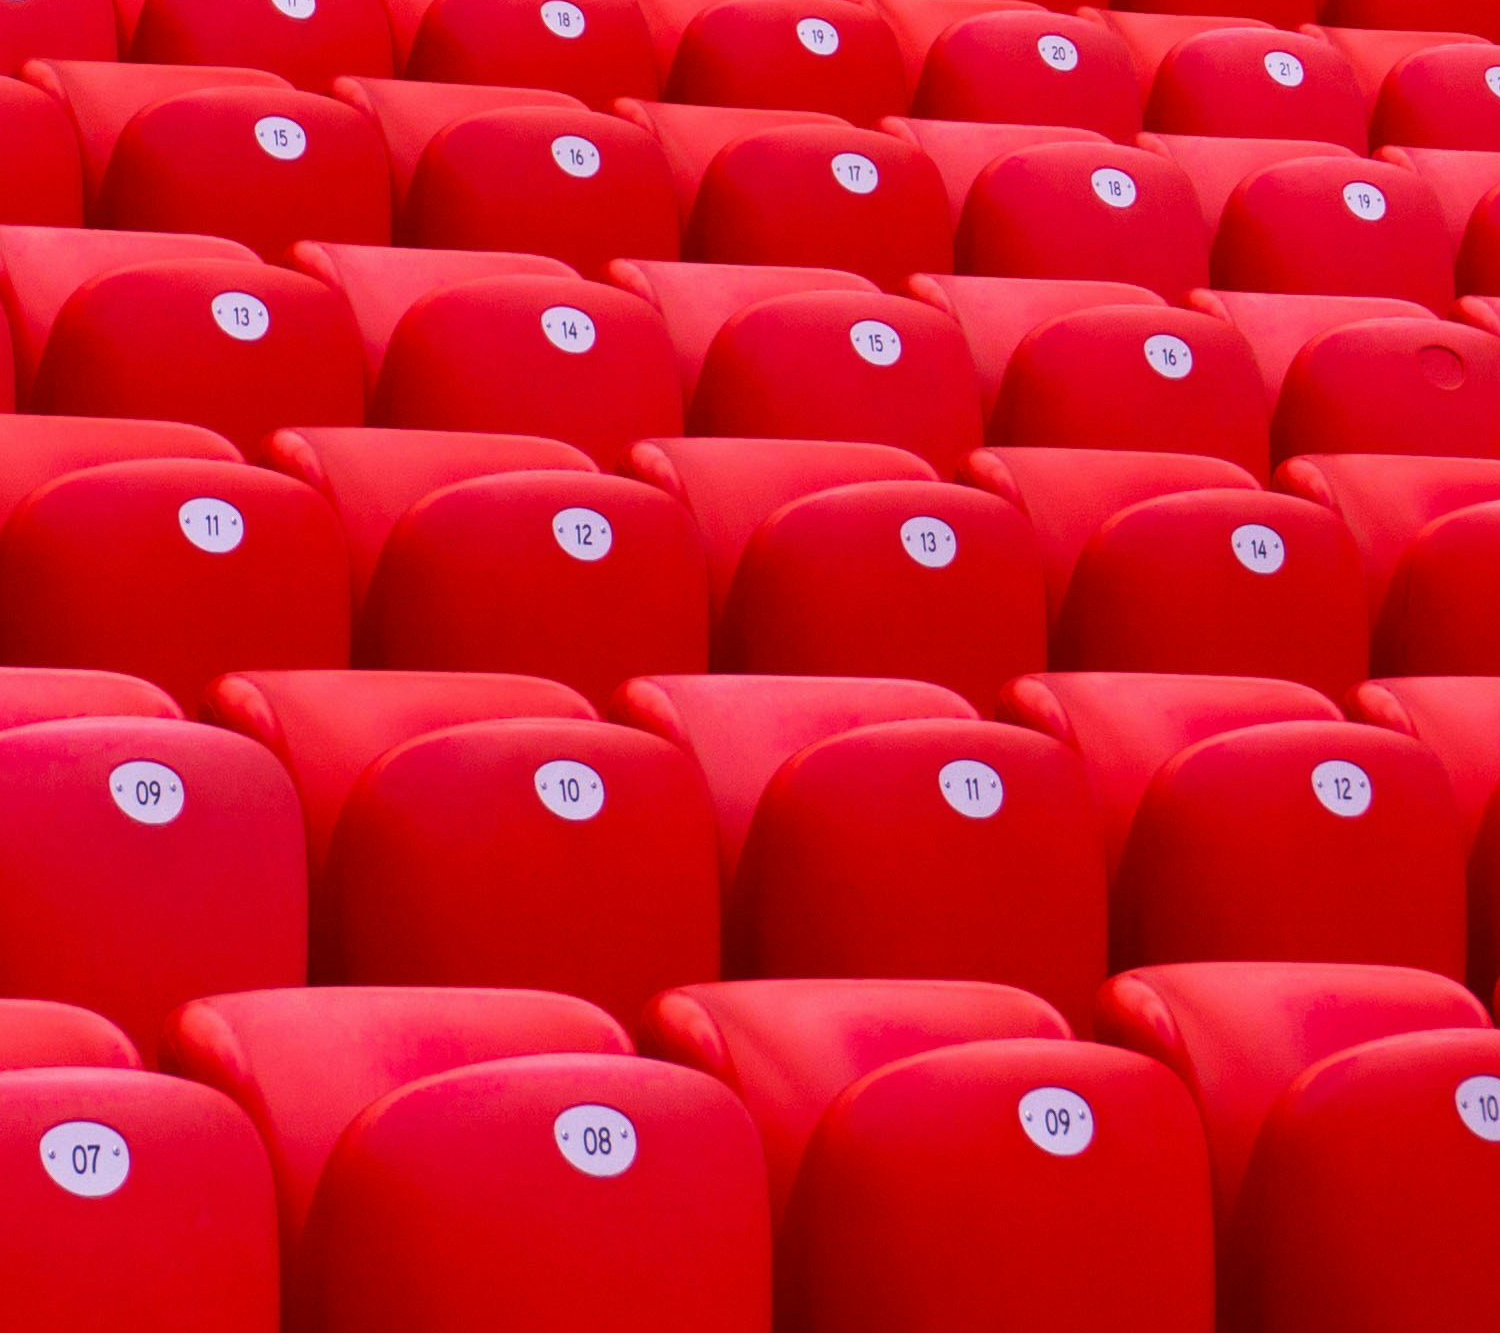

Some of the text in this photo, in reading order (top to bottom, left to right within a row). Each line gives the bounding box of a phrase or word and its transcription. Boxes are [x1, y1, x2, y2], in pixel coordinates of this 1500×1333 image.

[557, 12, 571, 28] 18
[1279, 61, 1291, 77] 21
[273, 129, 289, 148] 15
[569, 148, 585, 166] 16
[848, 165, 861, 182] 17
[1108, 180, 1122, 197] 18
[233, 306, 250, 327] 13
[561, 320, 578, 340] 14
[868, 334, 884, 353] 15
[1162, 348, 1177, 367] 16
[205, 514, 220, 537] 11
[575, 523, 593, 546] 12
[920, 531, 937, 553] 13
[1251, 539, 1268, 559] 14
[135, 780, 162, 806] 09
[559, 777, 580, 803] 10
[964, 777, 980, 801] 11
[1333, 777, 1353, 801] 12
[1478, 1095, 1500, 1123] 10
[1045, 1108, 1071, 1137] 09
[583, 1126, 612, 1156] 08
[72, 1144, 101, 1175] 07
